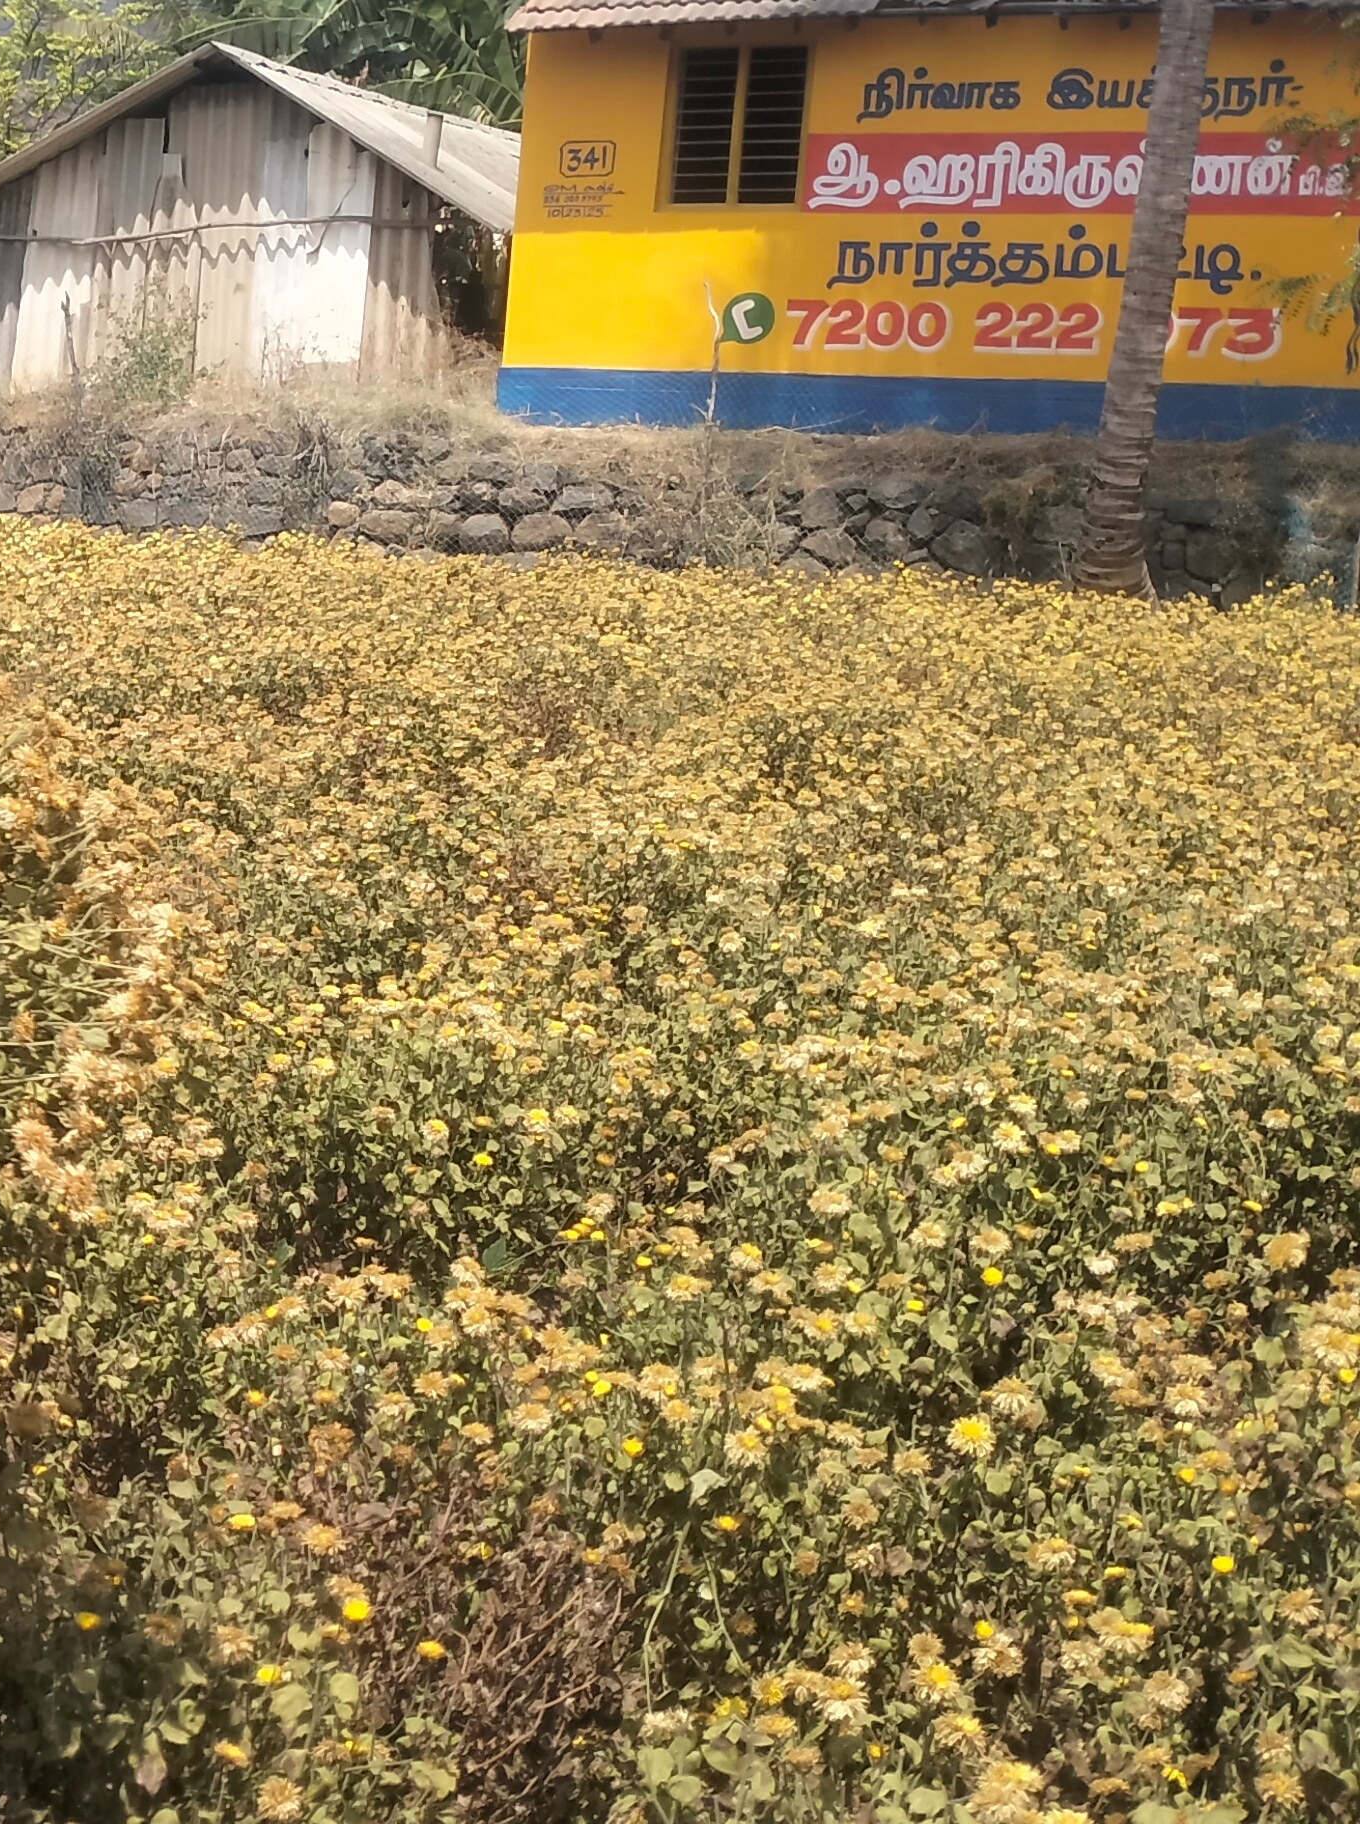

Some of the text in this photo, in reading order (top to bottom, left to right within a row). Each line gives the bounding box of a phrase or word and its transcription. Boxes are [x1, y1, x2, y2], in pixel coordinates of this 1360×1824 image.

[856, 67, 1021, 124] நிர்வாக
[567, 145, 607, 172] 341
[786, 298, 952, 352] 7200
[973, 302, 1105, 355] 222
